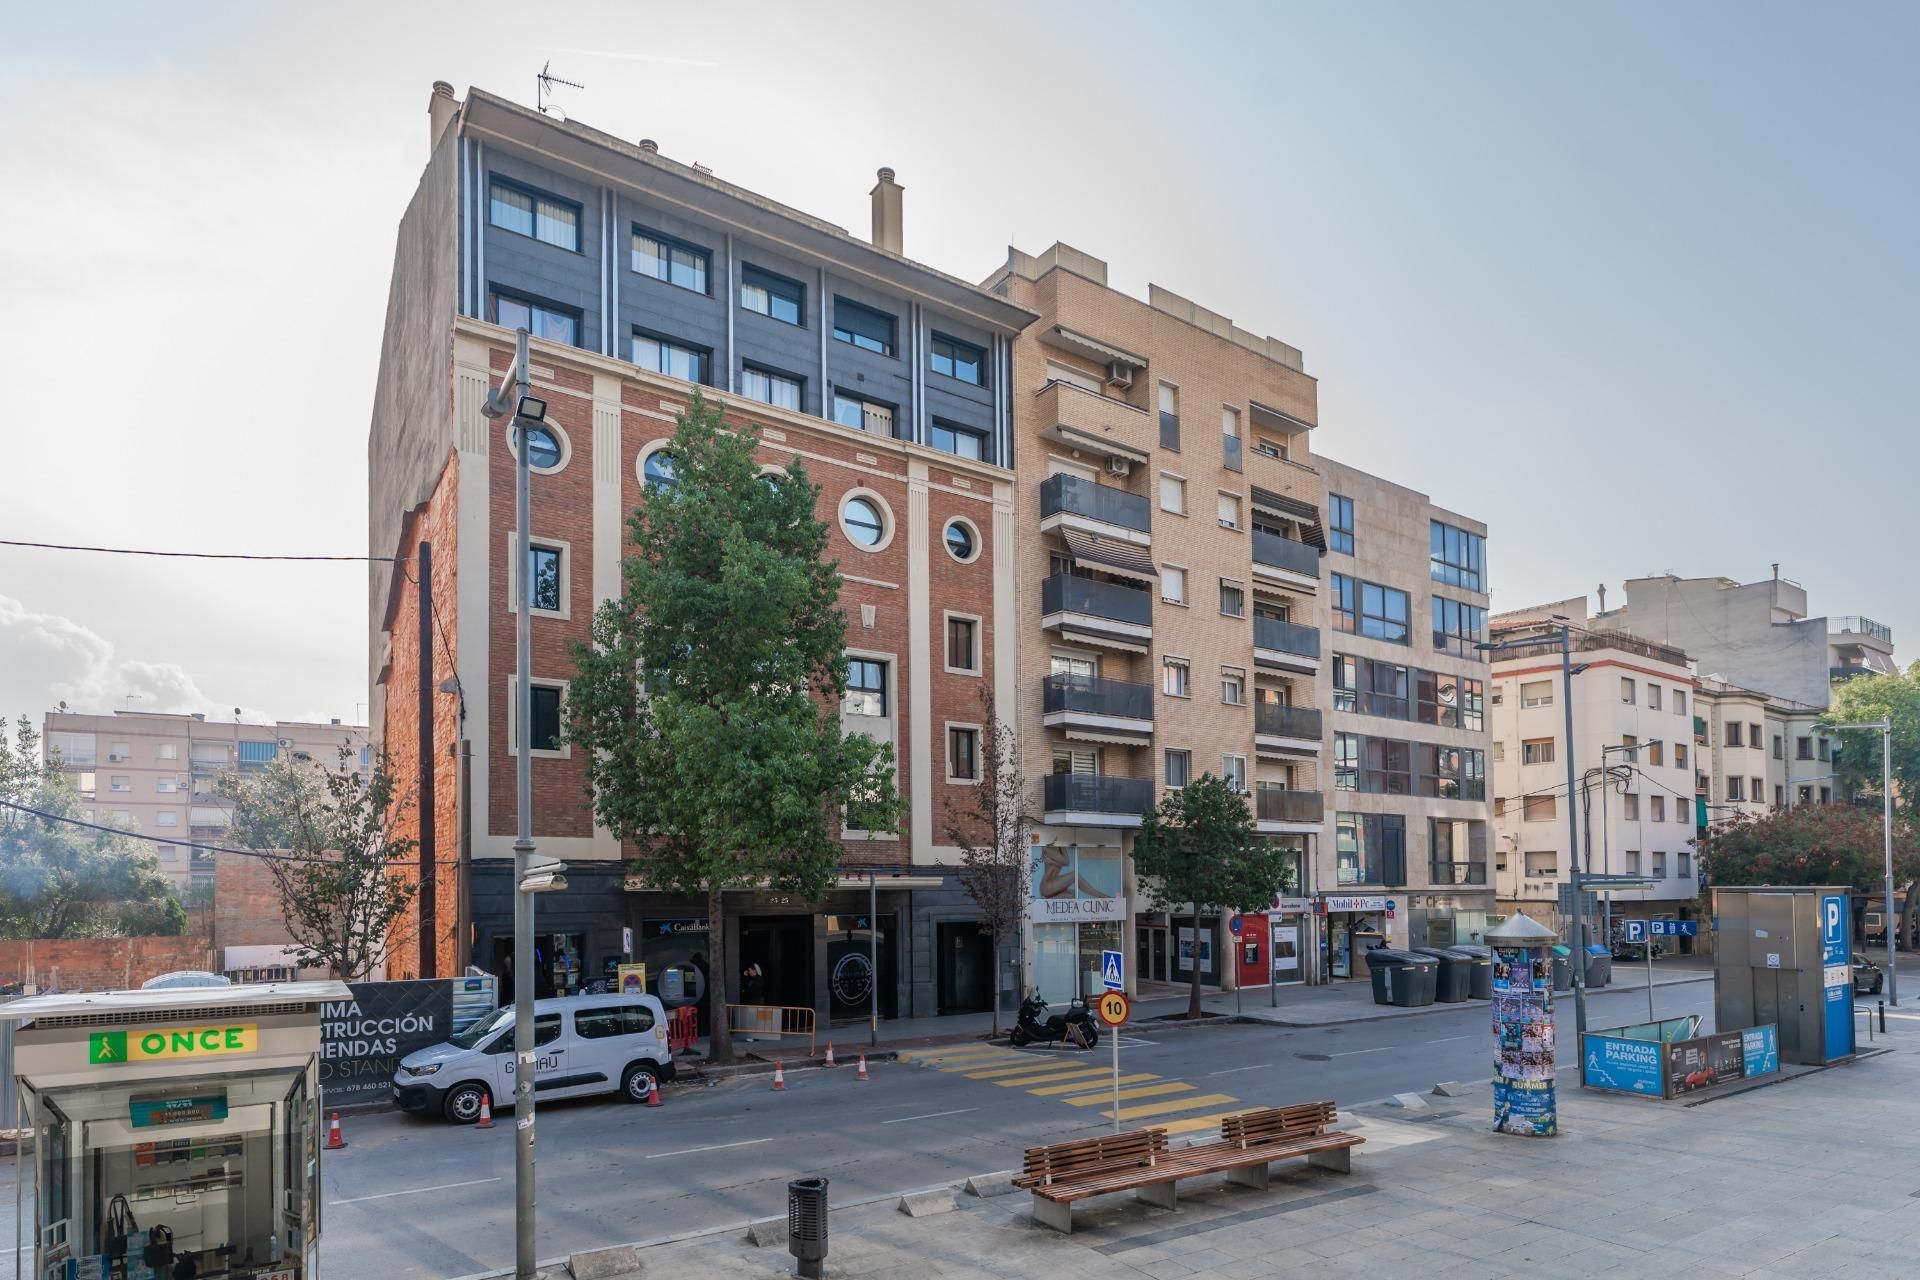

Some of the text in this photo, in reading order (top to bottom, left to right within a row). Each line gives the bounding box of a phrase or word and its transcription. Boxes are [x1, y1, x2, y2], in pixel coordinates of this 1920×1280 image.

[1083, 900, 1116, 914] CLINIC
[1332, 898, 1353, 909] Mobil
[1827, 903, 1839, 938] P
[1629, 923, 1641, 941] P
[320, 1001, 362, 1019] IMA
[1105, 1001, 1122, 1016] 10
[320, 1012, 433, 1039] TRUCCIÓN
[141, 1027, 244, 1055] ONCE
[320, 1038, 397, 1059] IENDAS
[1605, 1041, 1657, 1056] ENTRADA
[1605, 1049, 1657, 1065] PARKING
[1512, 1080, 1548, 1090] SUMMER
